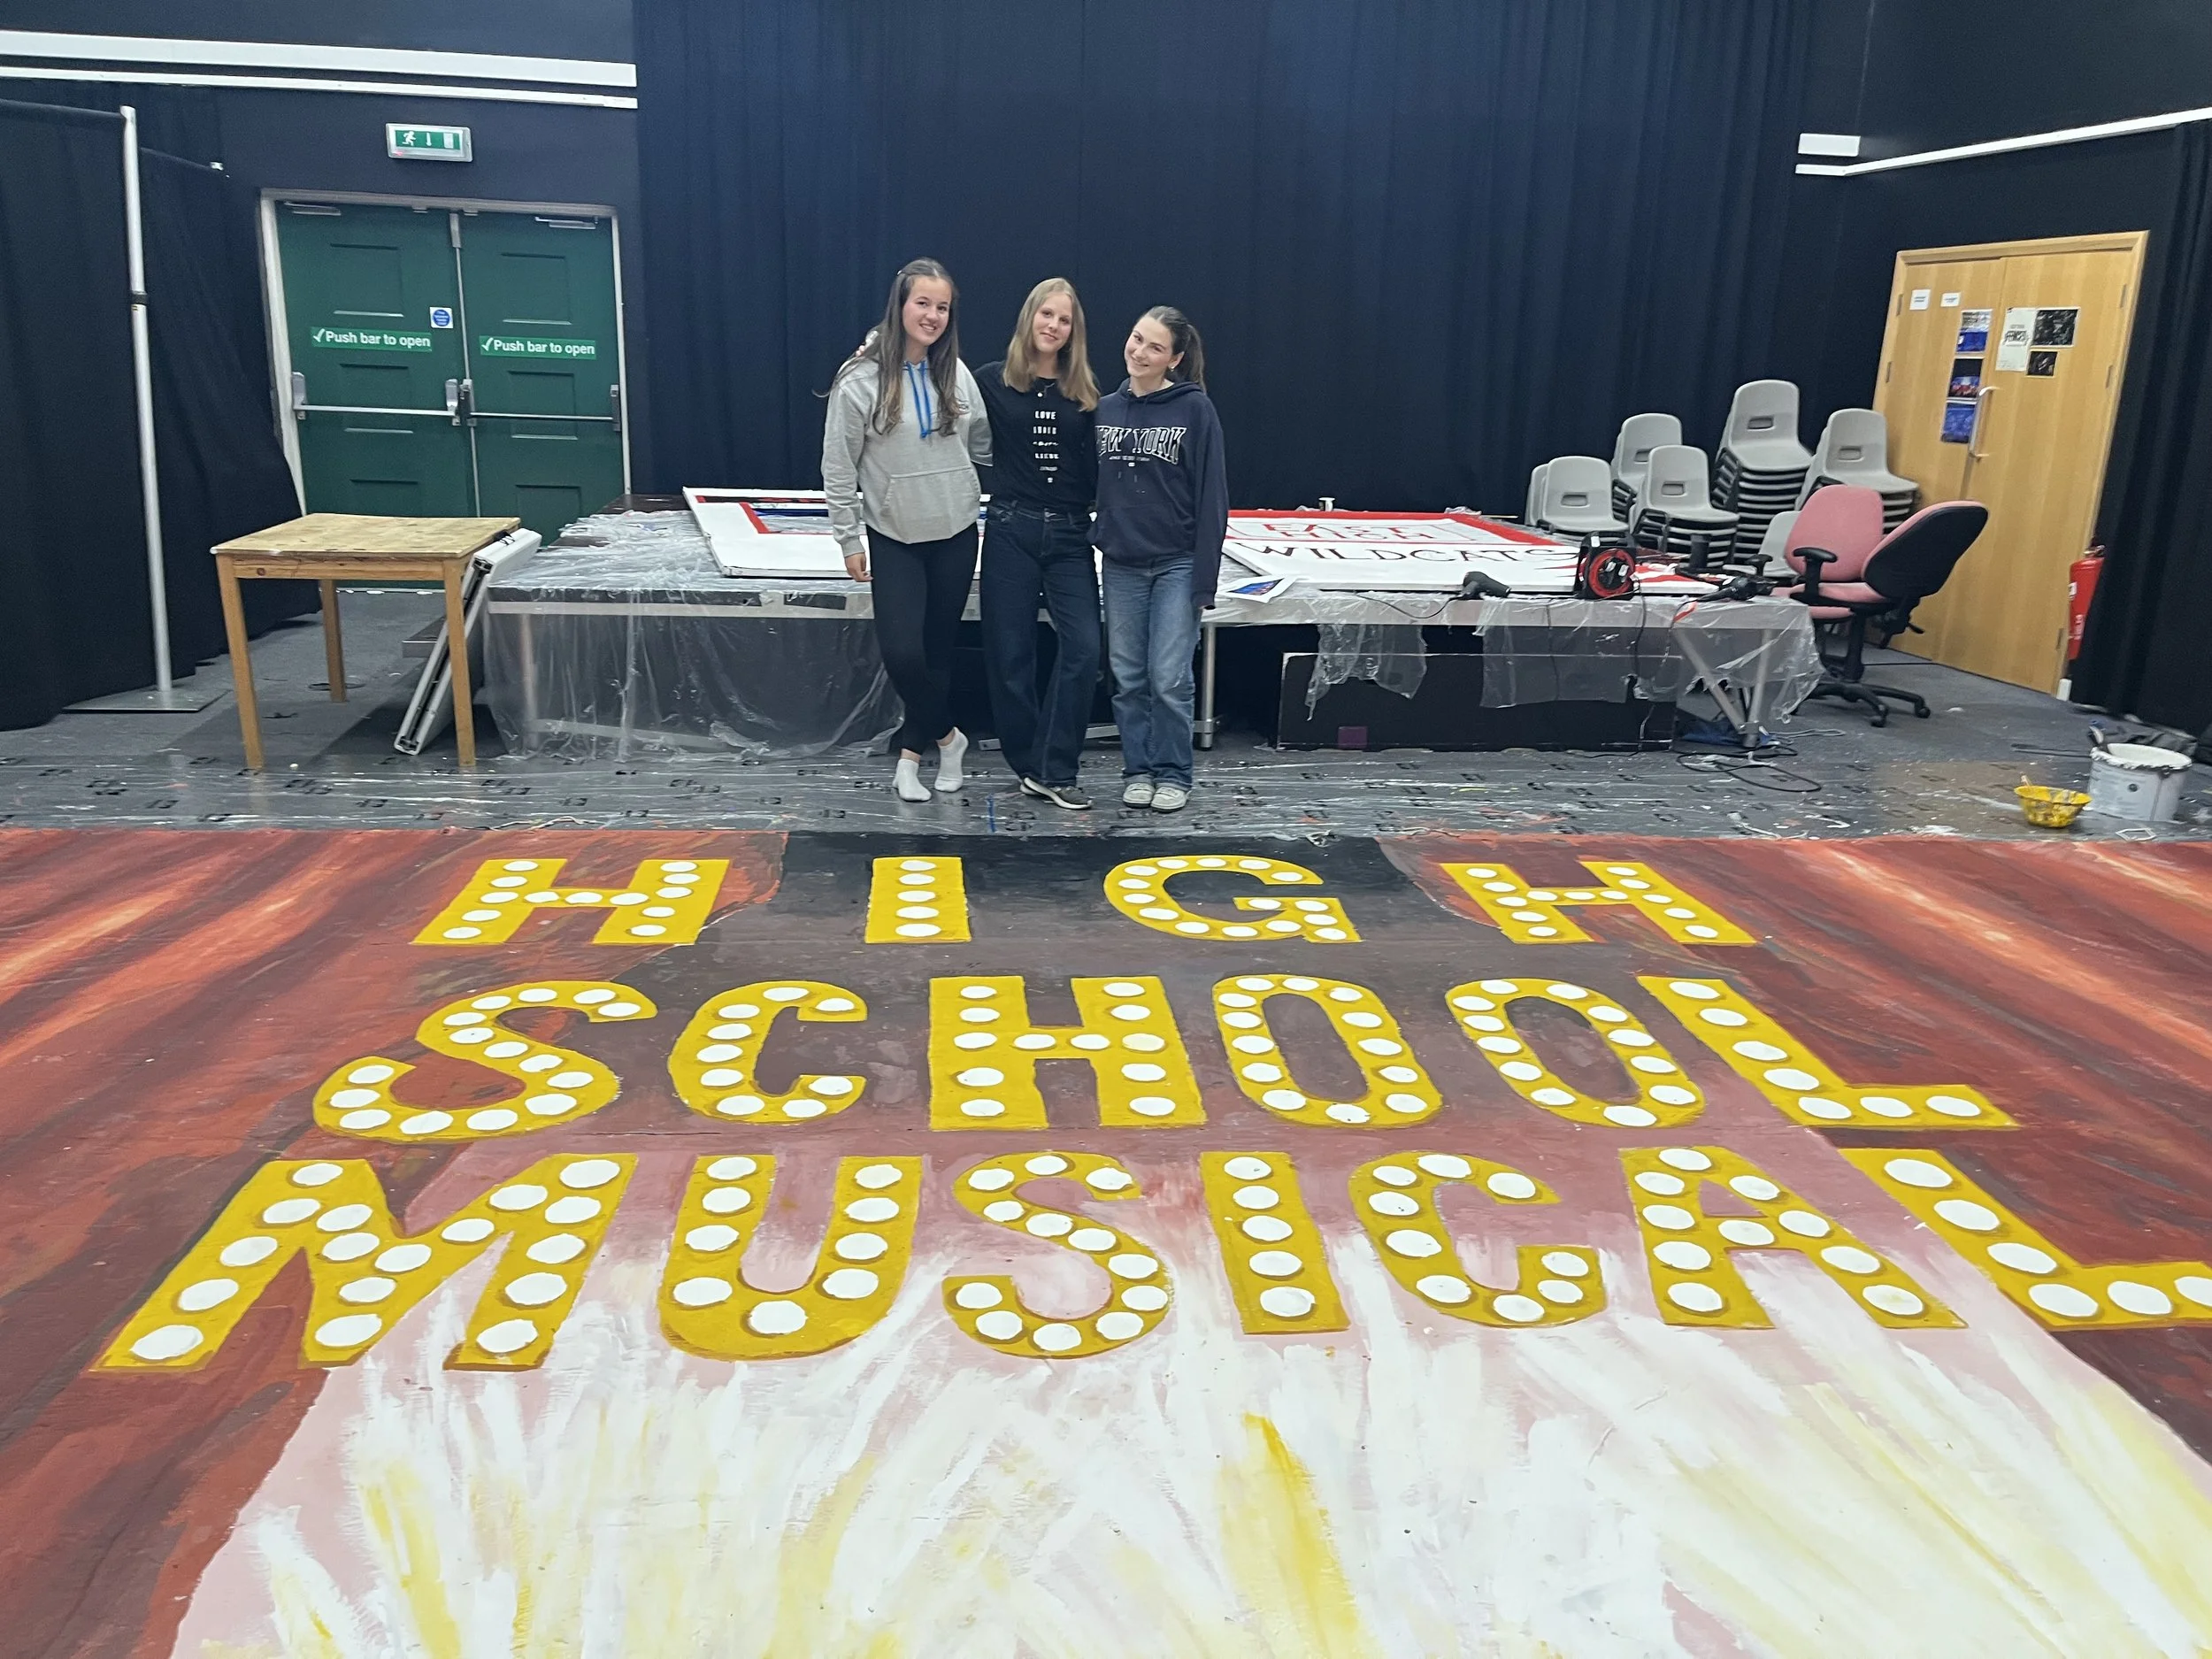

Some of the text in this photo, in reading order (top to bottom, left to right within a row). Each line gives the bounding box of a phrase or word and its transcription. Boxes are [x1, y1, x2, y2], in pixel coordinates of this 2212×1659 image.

[325, 330, 431, 349] Push bar to open
[493, 339, 595, 357] Push bar to open
[1034, 411, 1056, 419] LOVE
[1094, 425, 1187, 465] EW YORK
[1263, 524, 1410, 534] EAST
[1279, 531, 1437, 540] HIGH
[1232, 541, 1579, 562] WILDCATS
[410, 855, 1756, 946] HIGH
[312, 973, 2020, 1141] SCHOOL
[90, 1147, 2212, 1371] MUSICAL
